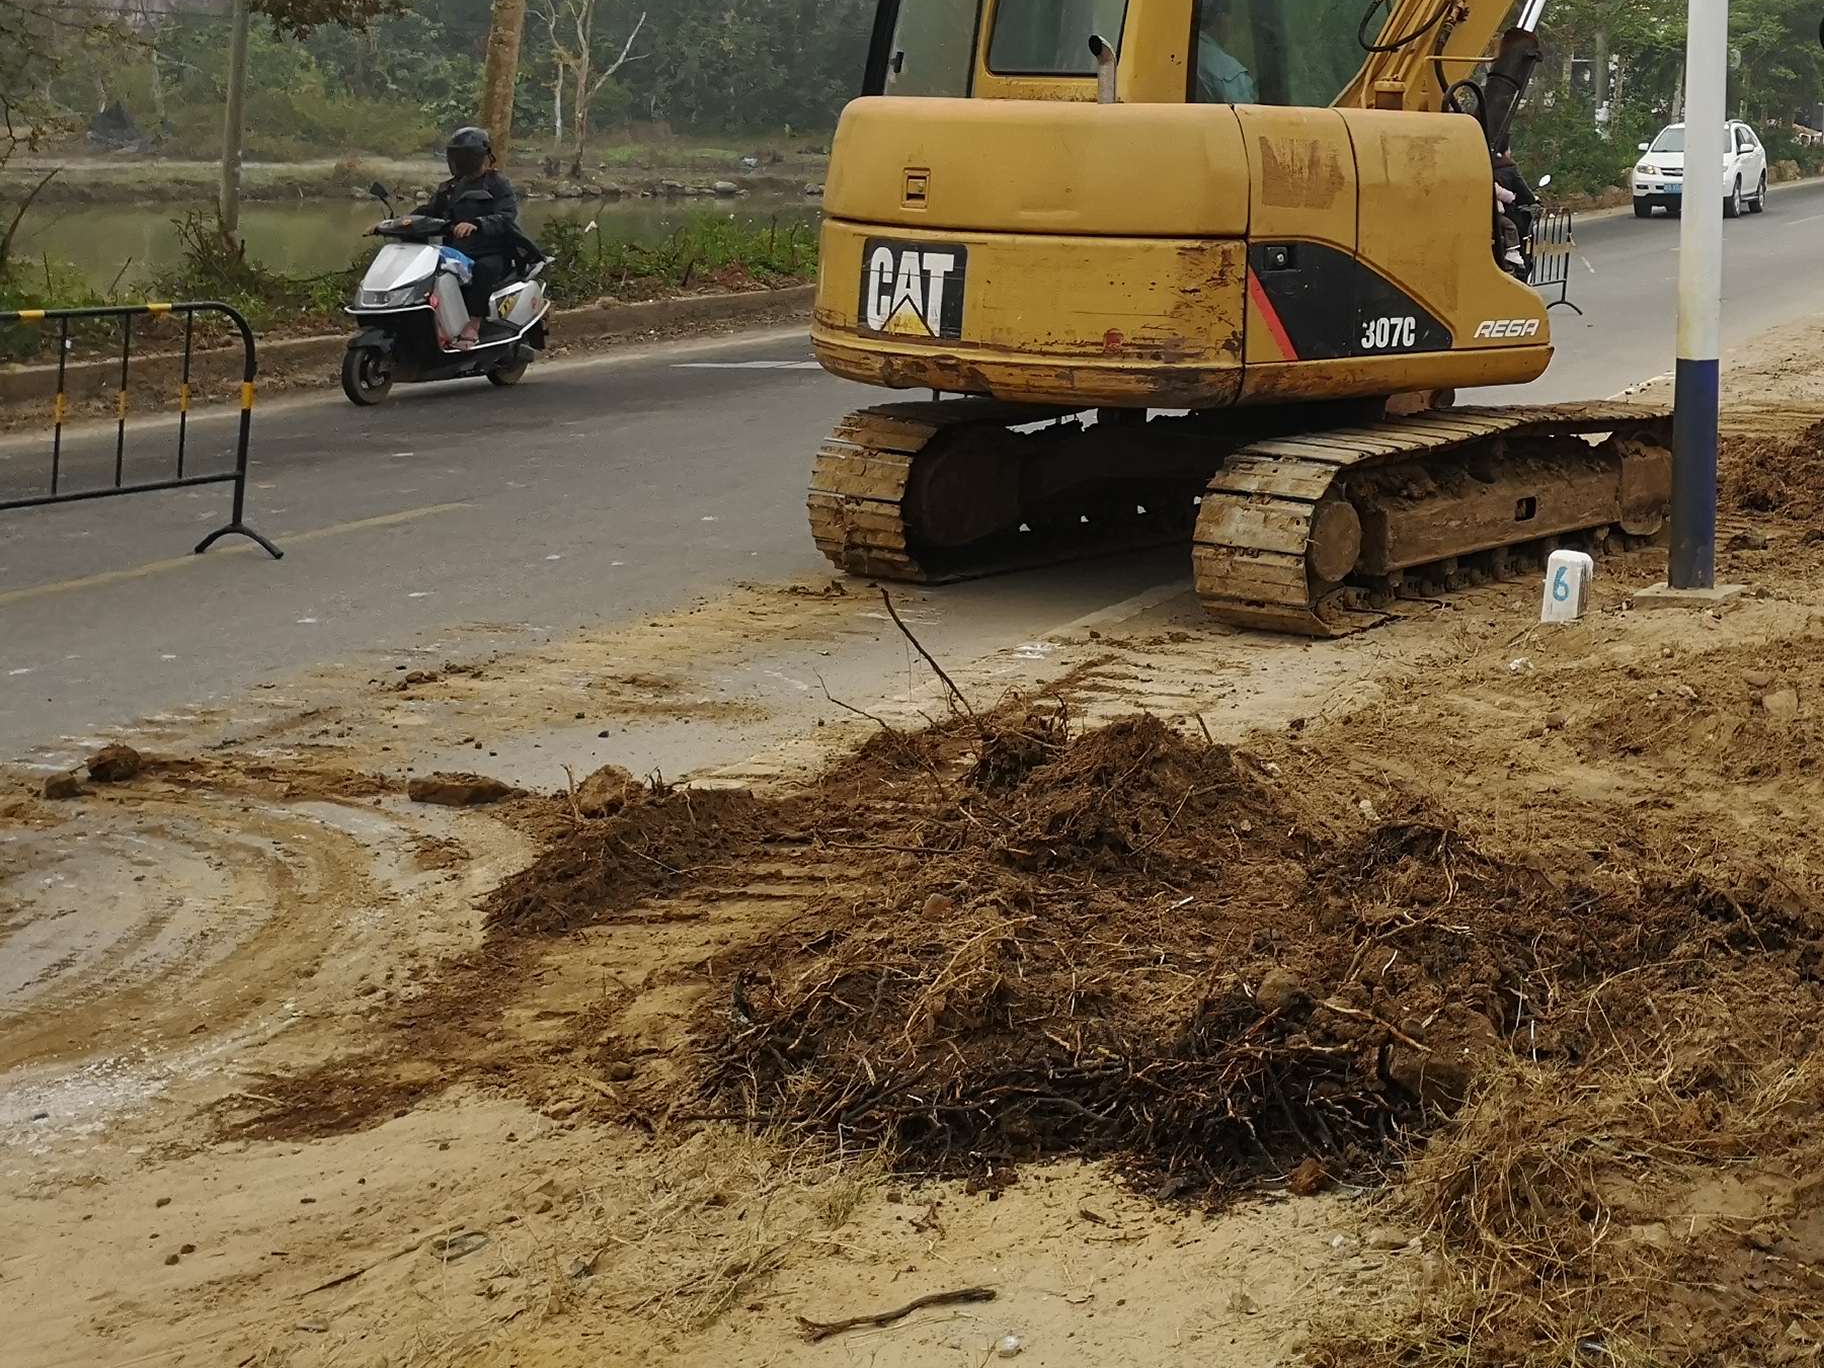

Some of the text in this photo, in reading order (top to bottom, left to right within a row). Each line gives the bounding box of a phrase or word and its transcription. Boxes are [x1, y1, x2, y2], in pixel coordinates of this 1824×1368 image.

[867, 246, 954, 338] CAT
[1361, 316, 1416, 349] 307C
[1473, 318, 1540, 339] REGA
[1552, 565, 1570, 602] 6
